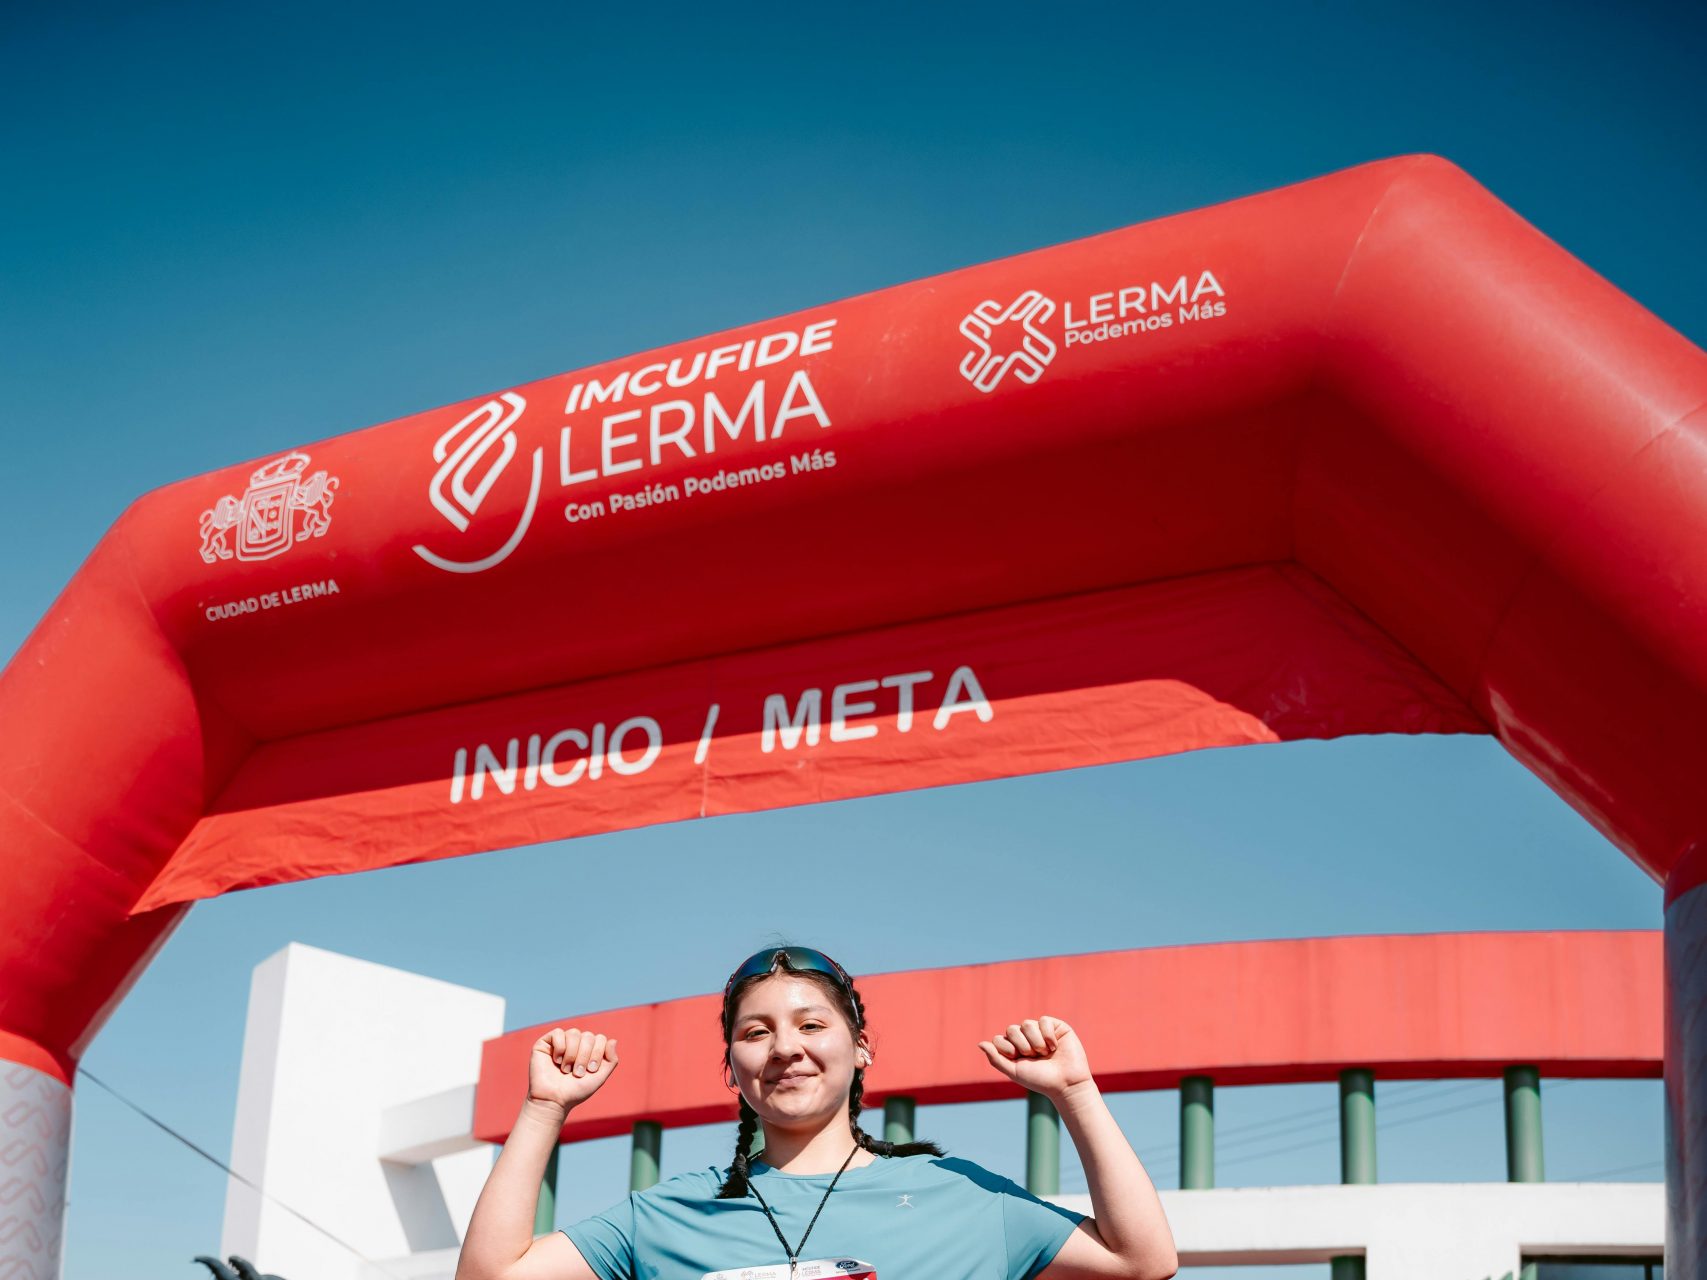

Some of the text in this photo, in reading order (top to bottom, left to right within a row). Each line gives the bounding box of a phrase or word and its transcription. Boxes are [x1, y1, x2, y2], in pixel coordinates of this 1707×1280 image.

[1064, 270, 1225, 329] LERMA
[1064, 299, 1227, 348] Podemos Más
[564, 319, 837, 414] IMCUFIDE
[560, 370, 831, 486] LERMA
[564, 448, 837, 522] Con Pasión Podemos Más
[205, 579, 340, 621] CIUDAD DE LERMA
[449, 666, 994, 804] INICIO / META
